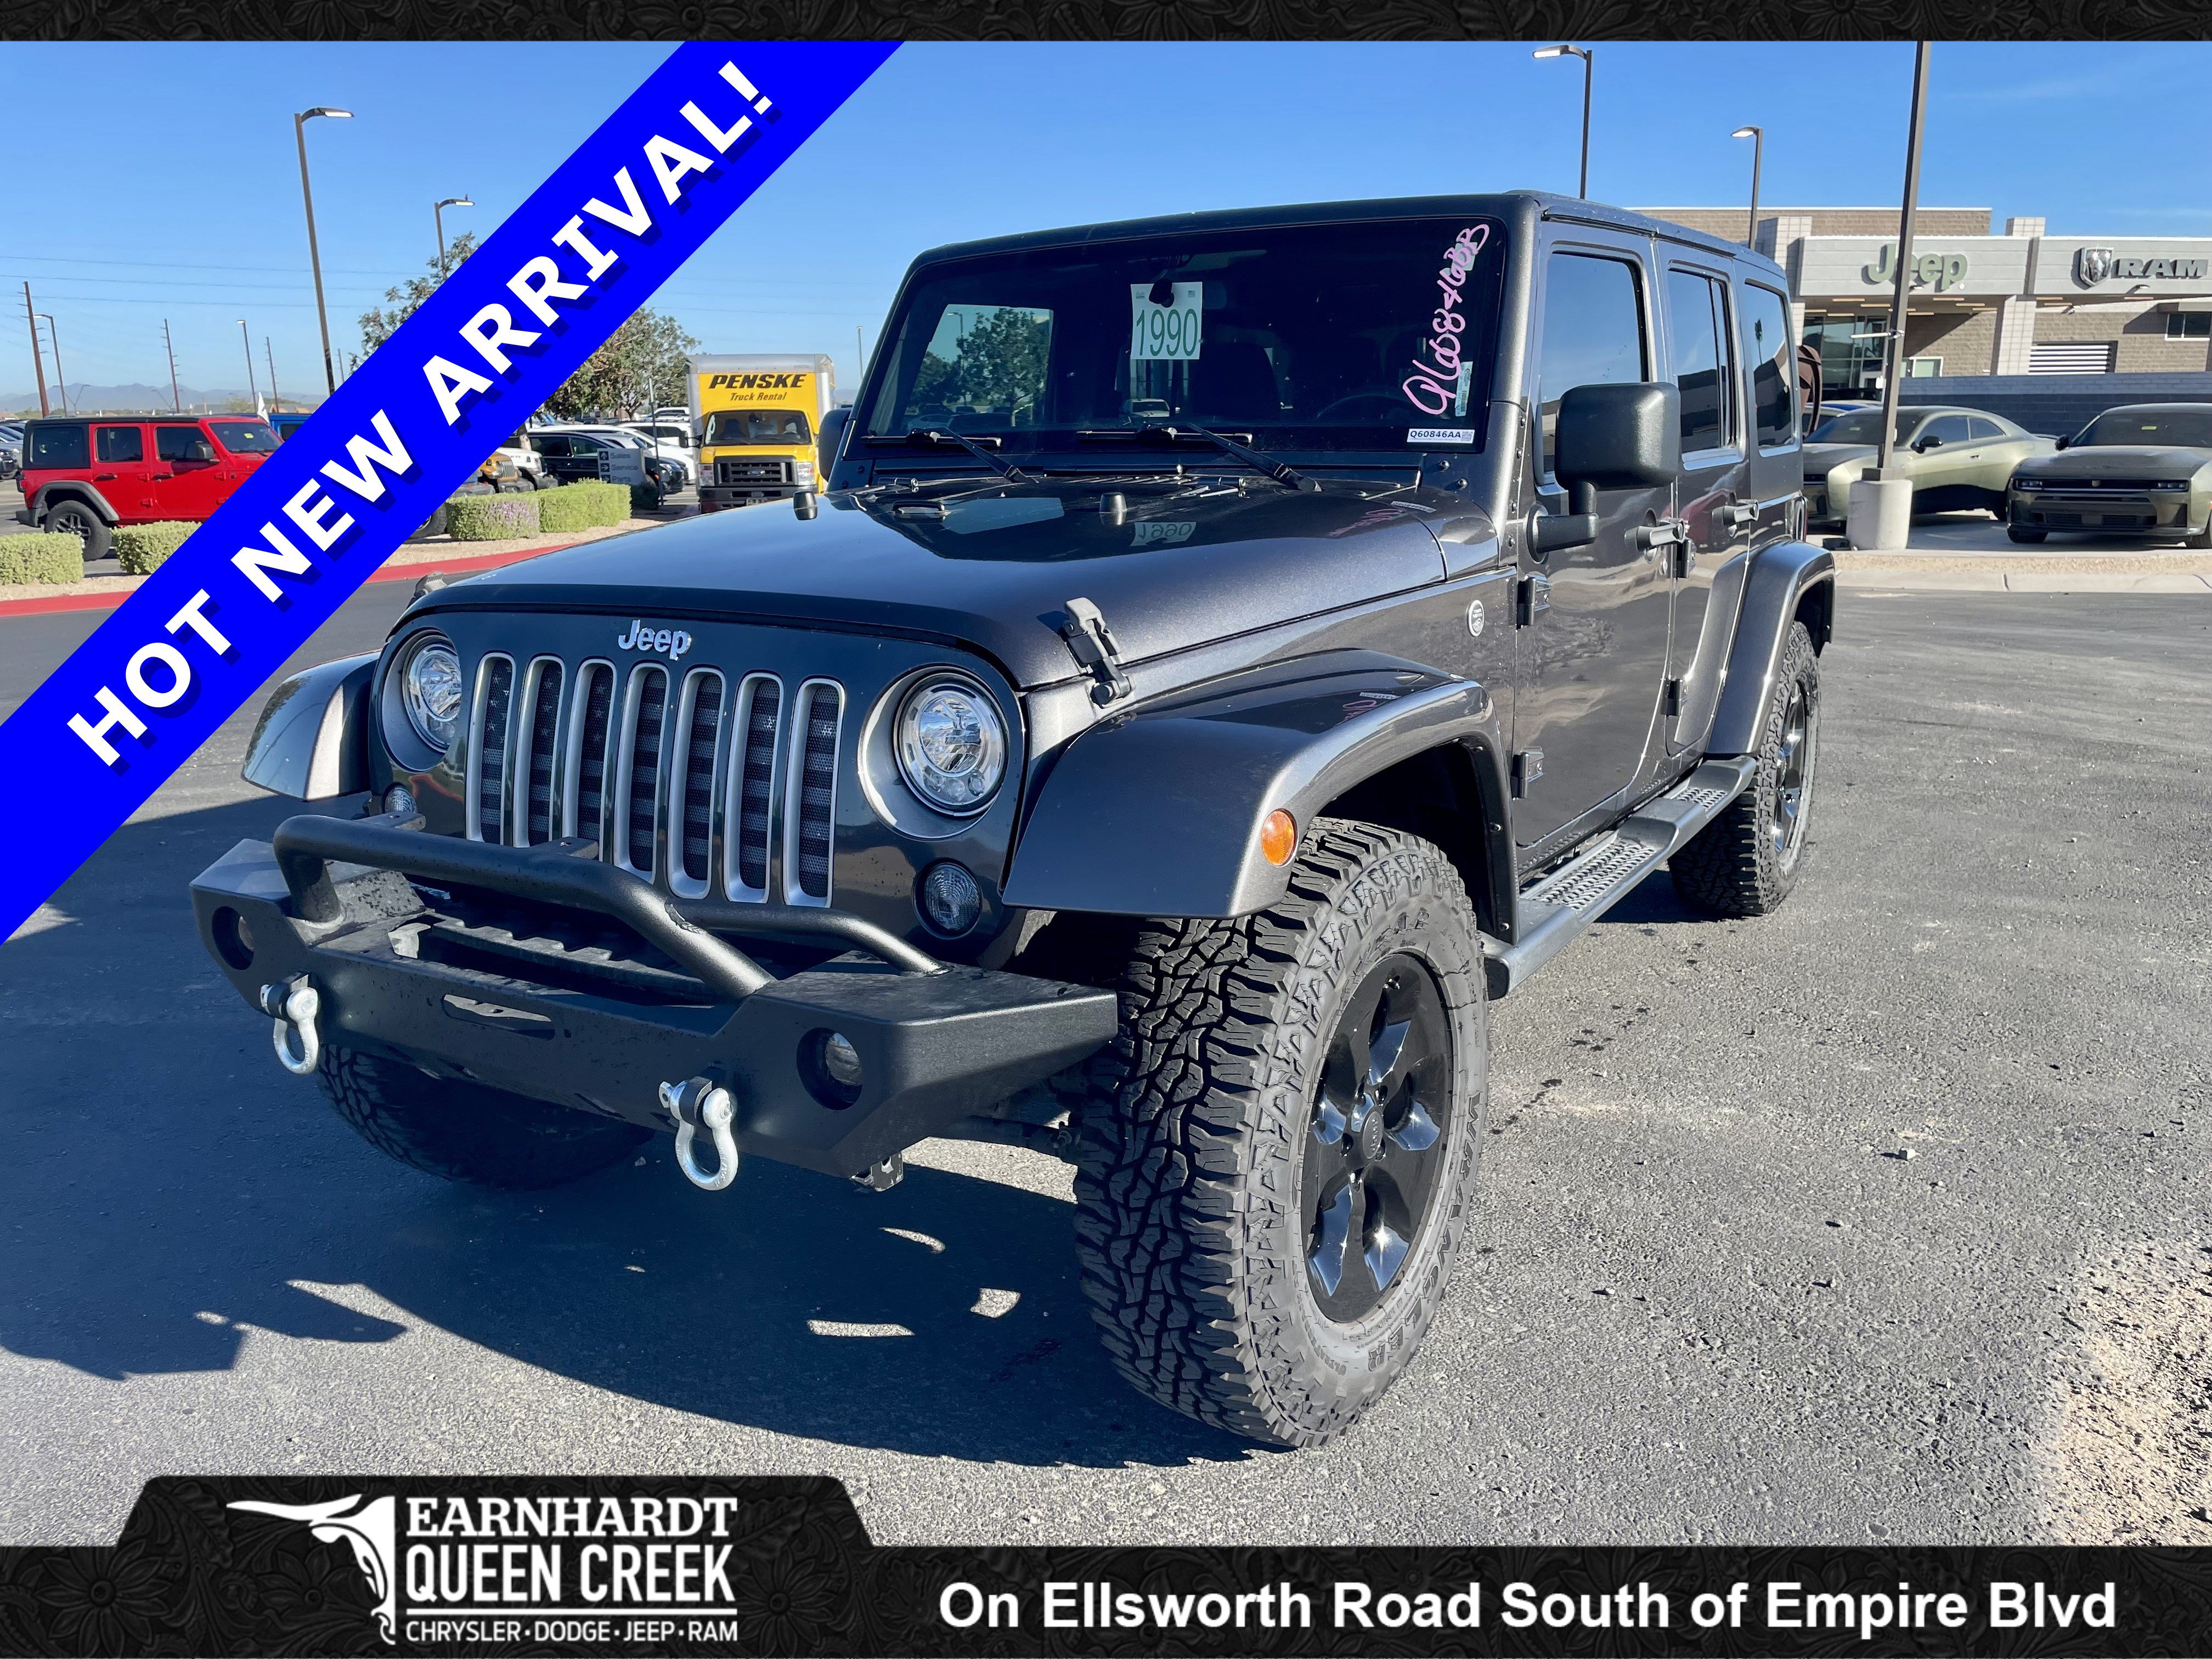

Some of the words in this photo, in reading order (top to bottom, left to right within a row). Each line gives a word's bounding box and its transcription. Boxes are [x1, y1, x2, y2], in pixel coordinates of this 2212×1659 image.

[2118, 258, 2208, 276] RAM
[1136, 308, 1198, 357] 1990
[708, 374, 807, 390] PENSKE
[730, 392, 755, 402] Truck
[756, 391, 787, 401] Rental
[1410, 430, 1461, 438] Q60846AA
[618, 619, 692, 661] Jeep
[1367, 1092, 1483, 1373] WRANGLER
